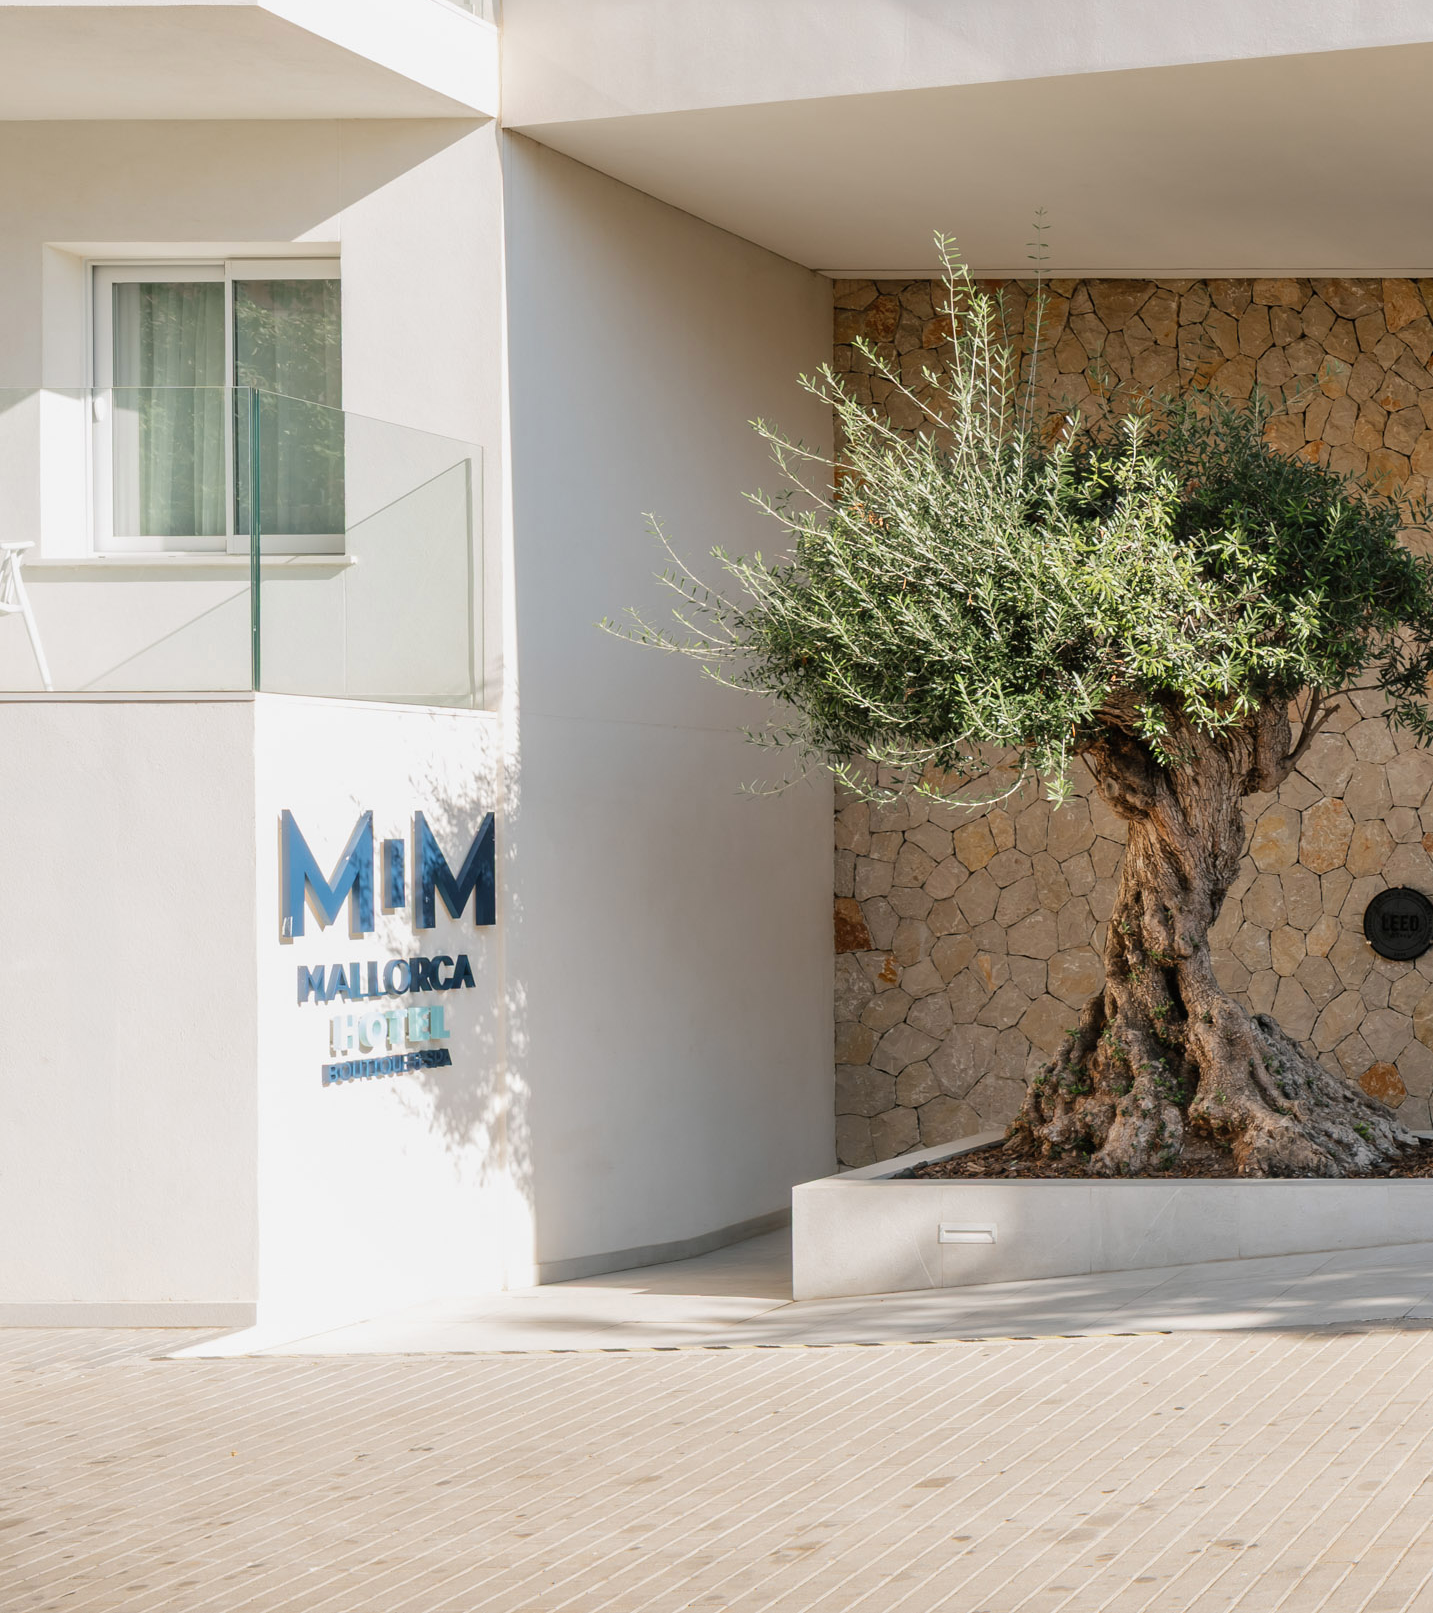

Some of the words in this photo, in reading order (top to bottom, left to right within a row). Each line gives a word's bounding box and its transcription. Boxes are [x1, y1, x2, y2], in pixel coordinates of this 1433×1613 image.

[1381, 914, 1420, 932] LEED
[298, 954, 476, 1001] MALLORCA
[332, 1005, 450, 1052] HOTEL
